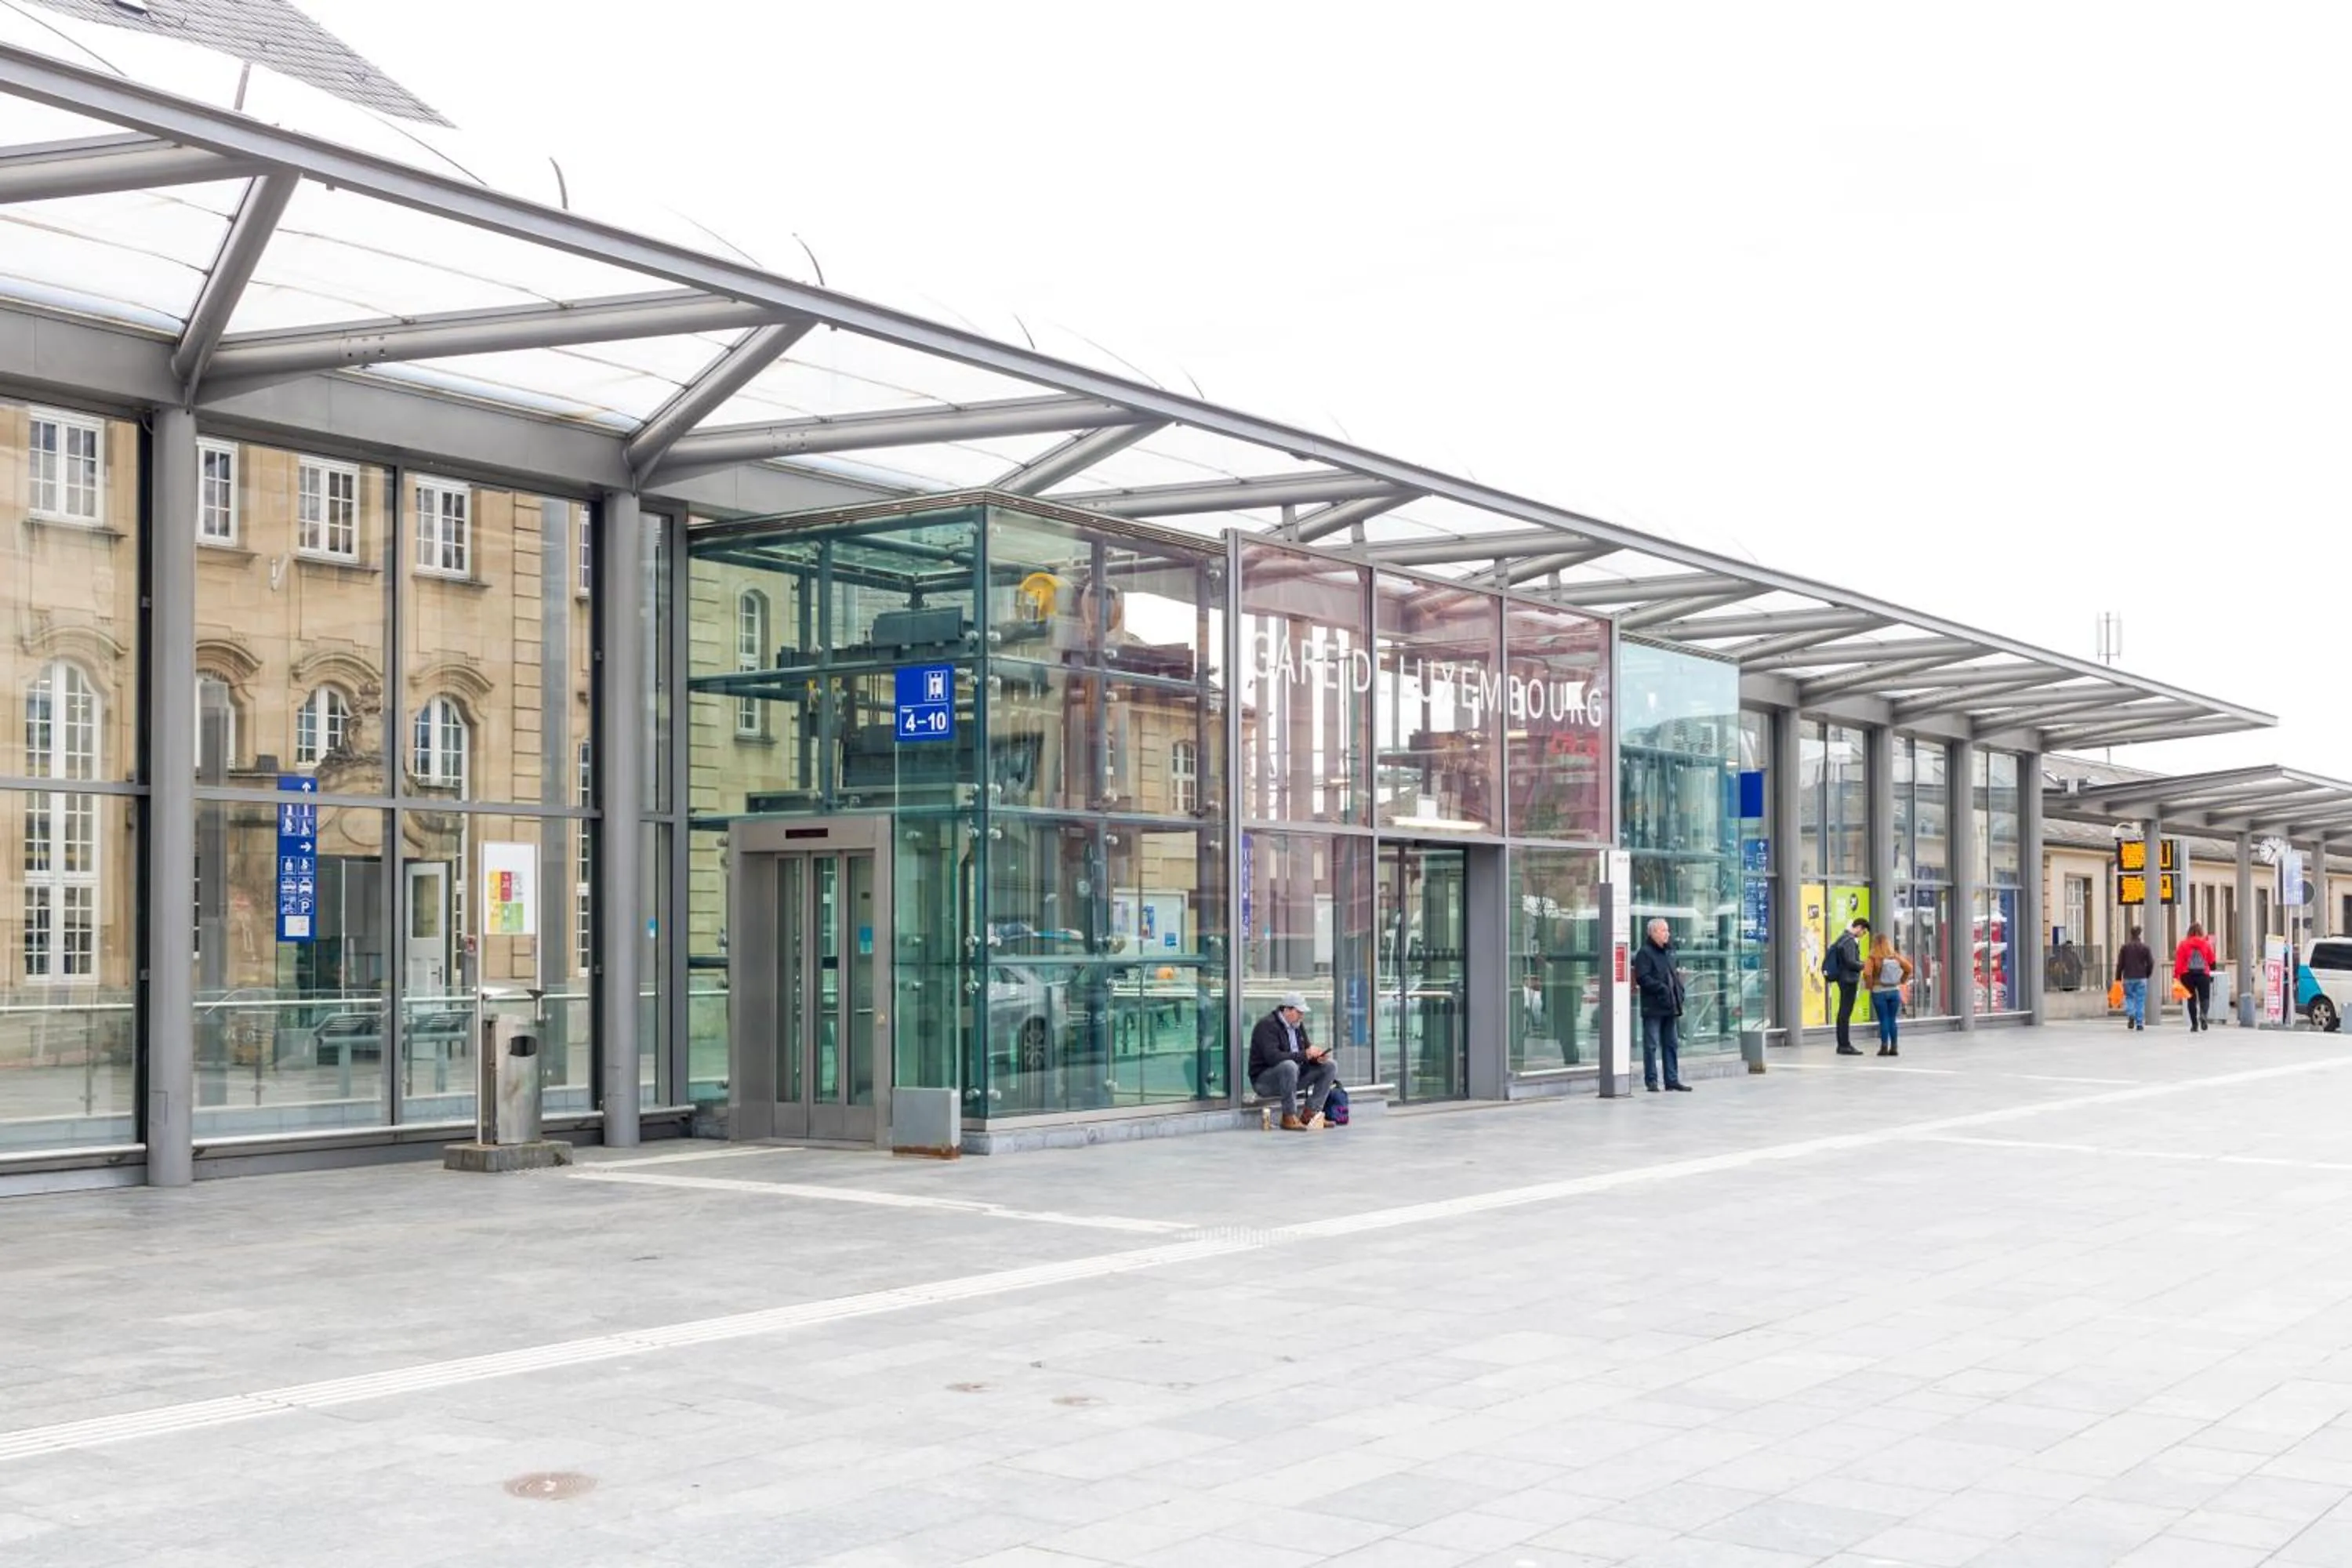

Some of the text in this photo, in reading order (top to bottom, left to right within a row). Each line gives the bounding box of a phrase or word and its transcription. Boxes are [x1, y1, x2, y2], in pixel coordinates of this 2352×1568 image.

[1250, 631, 1339, 689] GARE
[905, 711, 946, 731] 4-10
[301, 902, 309, 913] P
